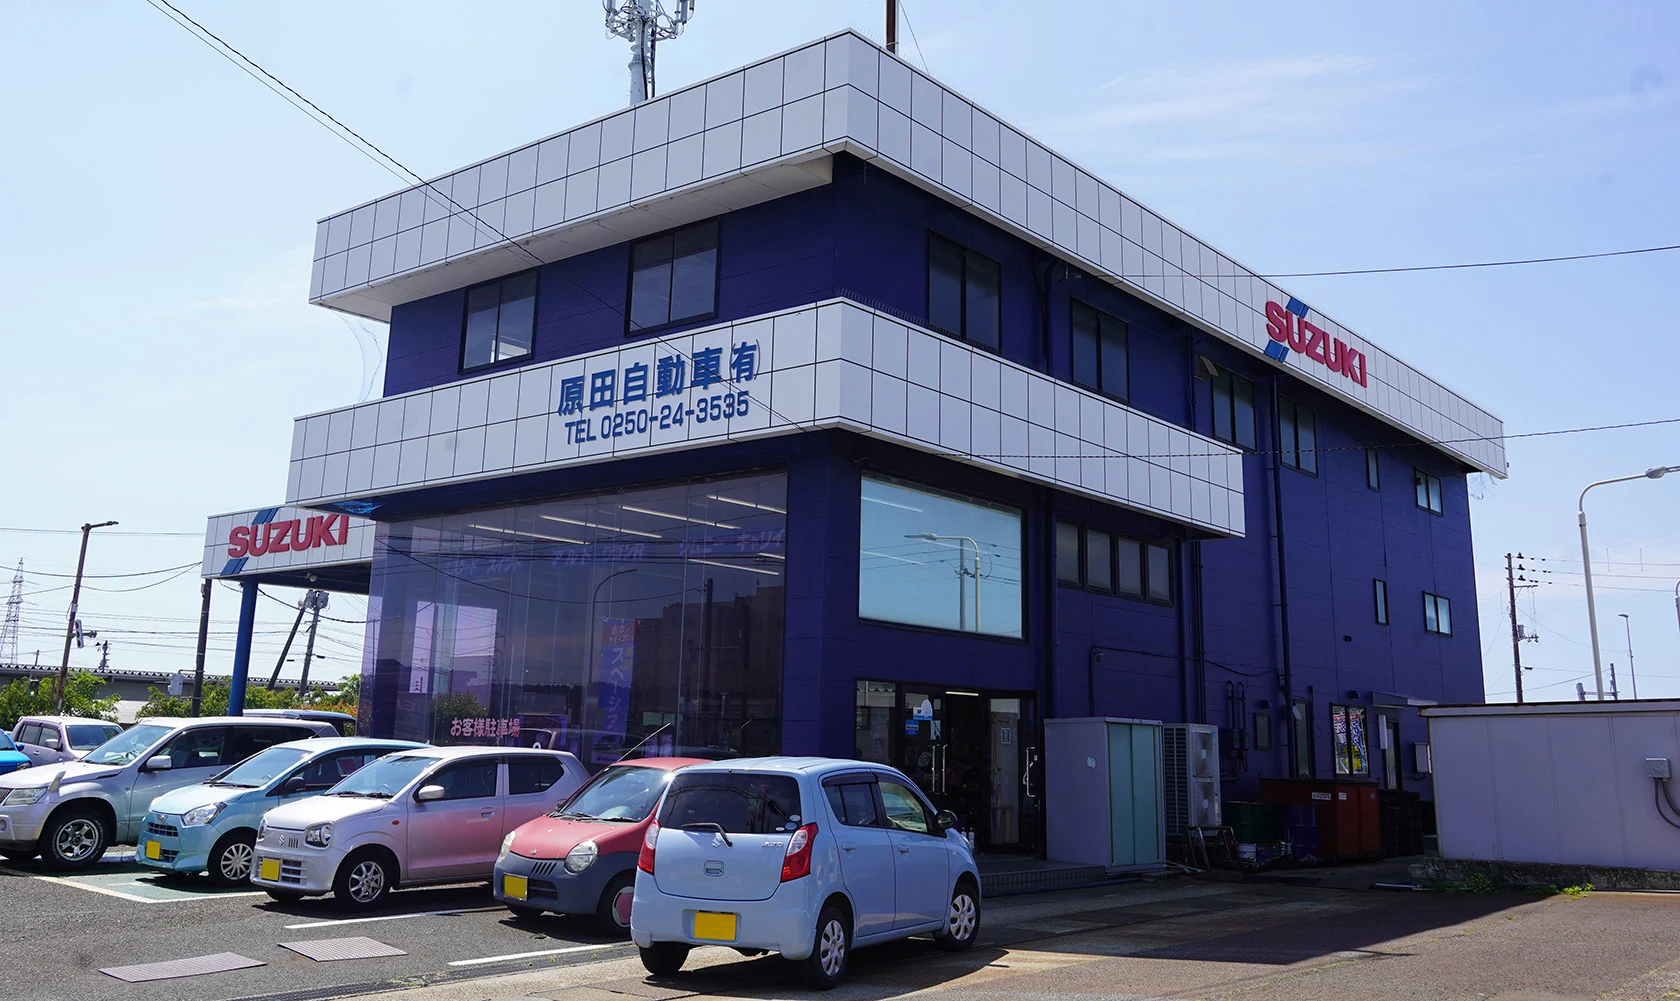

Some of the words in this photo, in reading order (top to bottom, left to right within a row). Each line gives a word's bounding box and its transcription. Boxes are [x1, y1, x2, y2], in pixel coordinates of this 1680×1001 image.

[1265, 301, 1367, 388] SUZUKI
[558, 339, 760, 416] 原田自動車(有)
[565, 420, 596, 444] TEL
[601, 391, 749, 439] 0250-24-3535
[228, 514, 349, 558] SUZUKI
[606, 647, 625, 731] スペーシア
[450, 717, 521, 738] お客様駐車場
